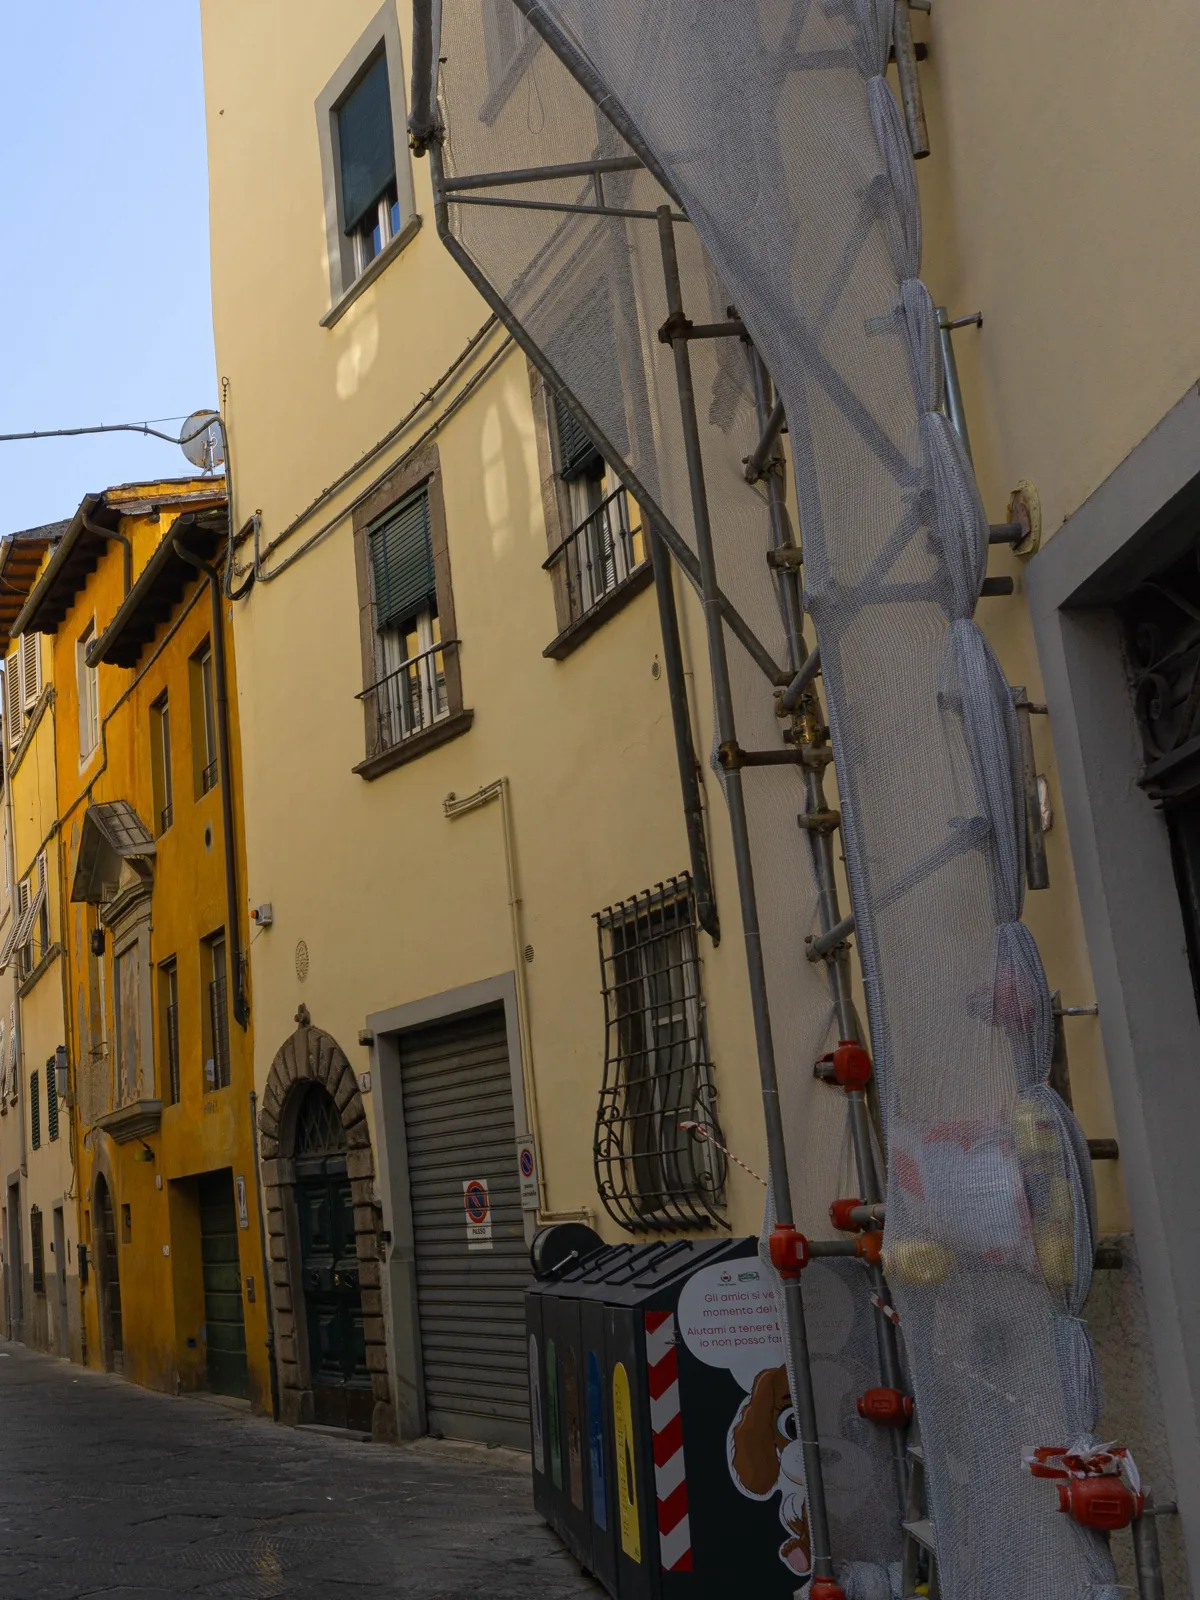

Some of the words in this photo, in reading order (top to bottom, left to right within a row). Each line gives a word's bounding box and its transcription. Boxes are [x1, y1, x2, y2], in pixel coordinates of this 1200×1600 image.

[704, 1293, 718, 1302] Gli
[720, 1291, 749, 1301] amici
[752, 1291, 760, 1300] si
[703, 1307, 753, 1316] momento
[755, 1305, 772, 1314] del
[687, 1325, 726, 1335] Aiutami
[729, 1326, 736, 1334] a
[739, 1324, 772, 1333] tenere
[700, 1338, 709, 1347] io
[711, 1338, 731, 1347] non
[734, 1336, 765, 1347] posso
